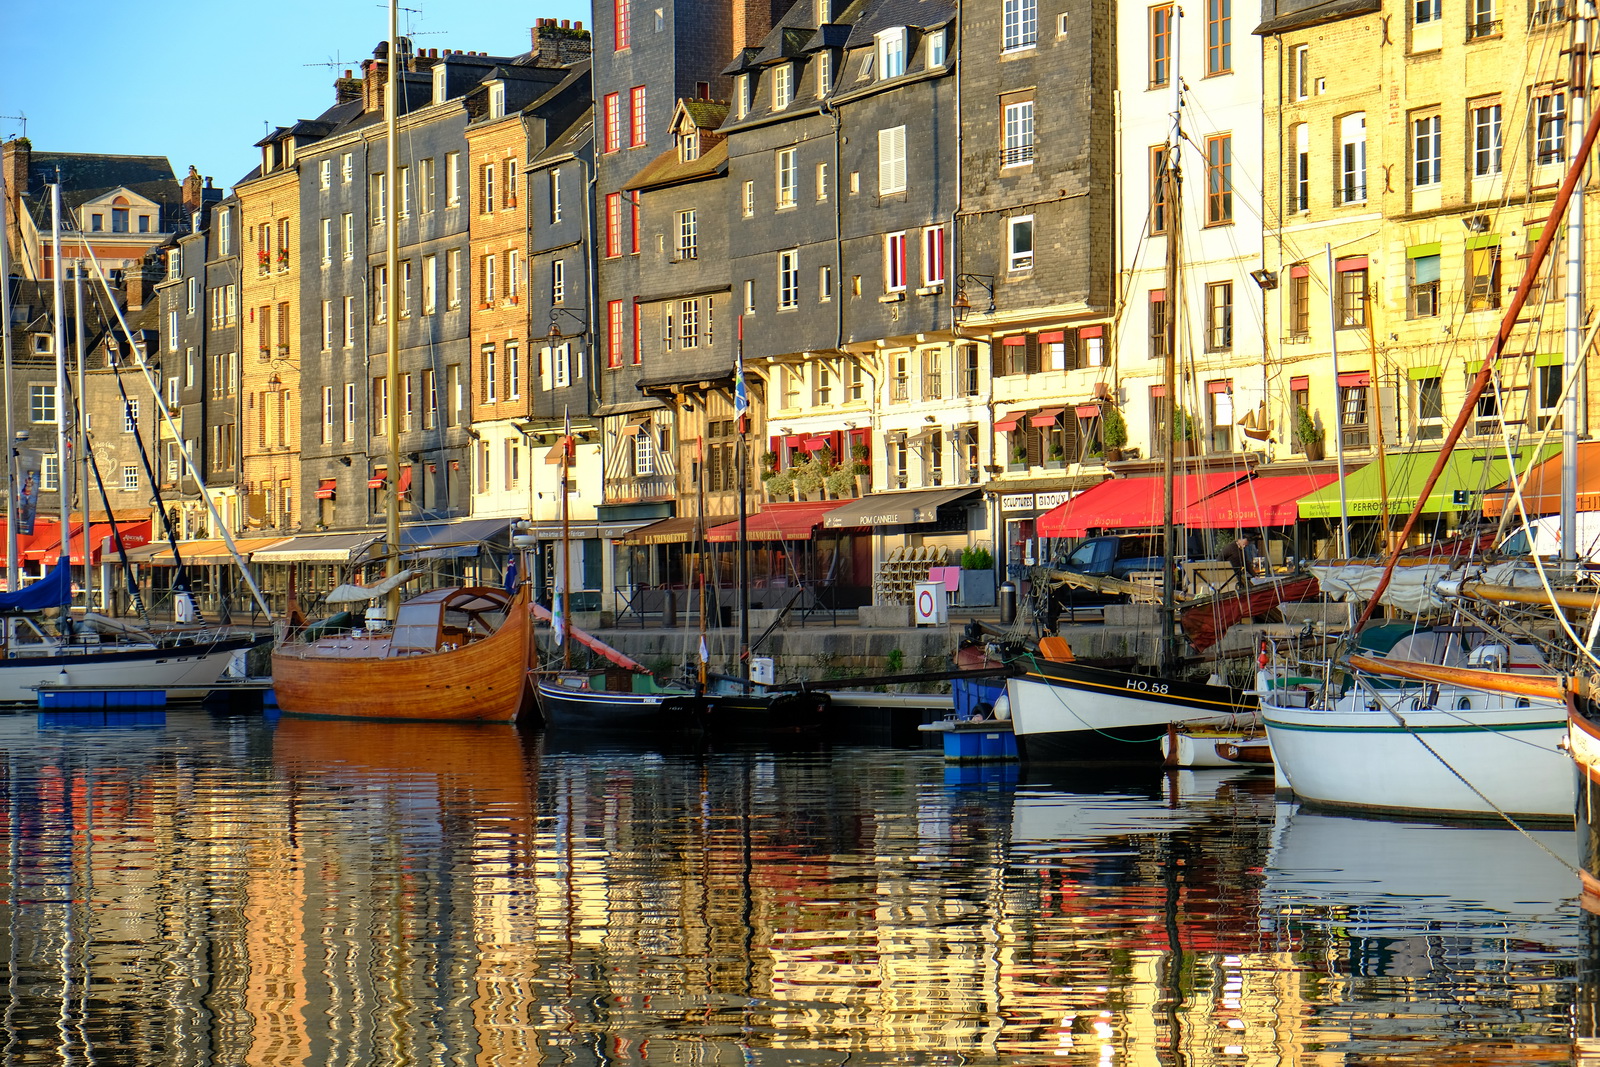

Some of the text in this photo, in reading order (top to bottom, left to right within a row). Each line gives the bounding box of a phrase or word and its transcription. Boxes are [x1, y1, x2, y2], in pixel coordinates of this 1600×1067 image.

[1003, 496, 1032, 508] SCULPTURES
[1353, 500, 1401, 512] PERROUET
[859, 514, 898, 525] POM CANNELLE
[1218, 512, 1225, 520] LA
[1227, 509, 1257, 520] BISQUINE
[645, 535, 653, 544] LA
[653, 532, 688, 543] TRINQUETTE
[746, 530, 783, 540] TRINQUETTE
[1126, 679, 1169, 694] HO.58
